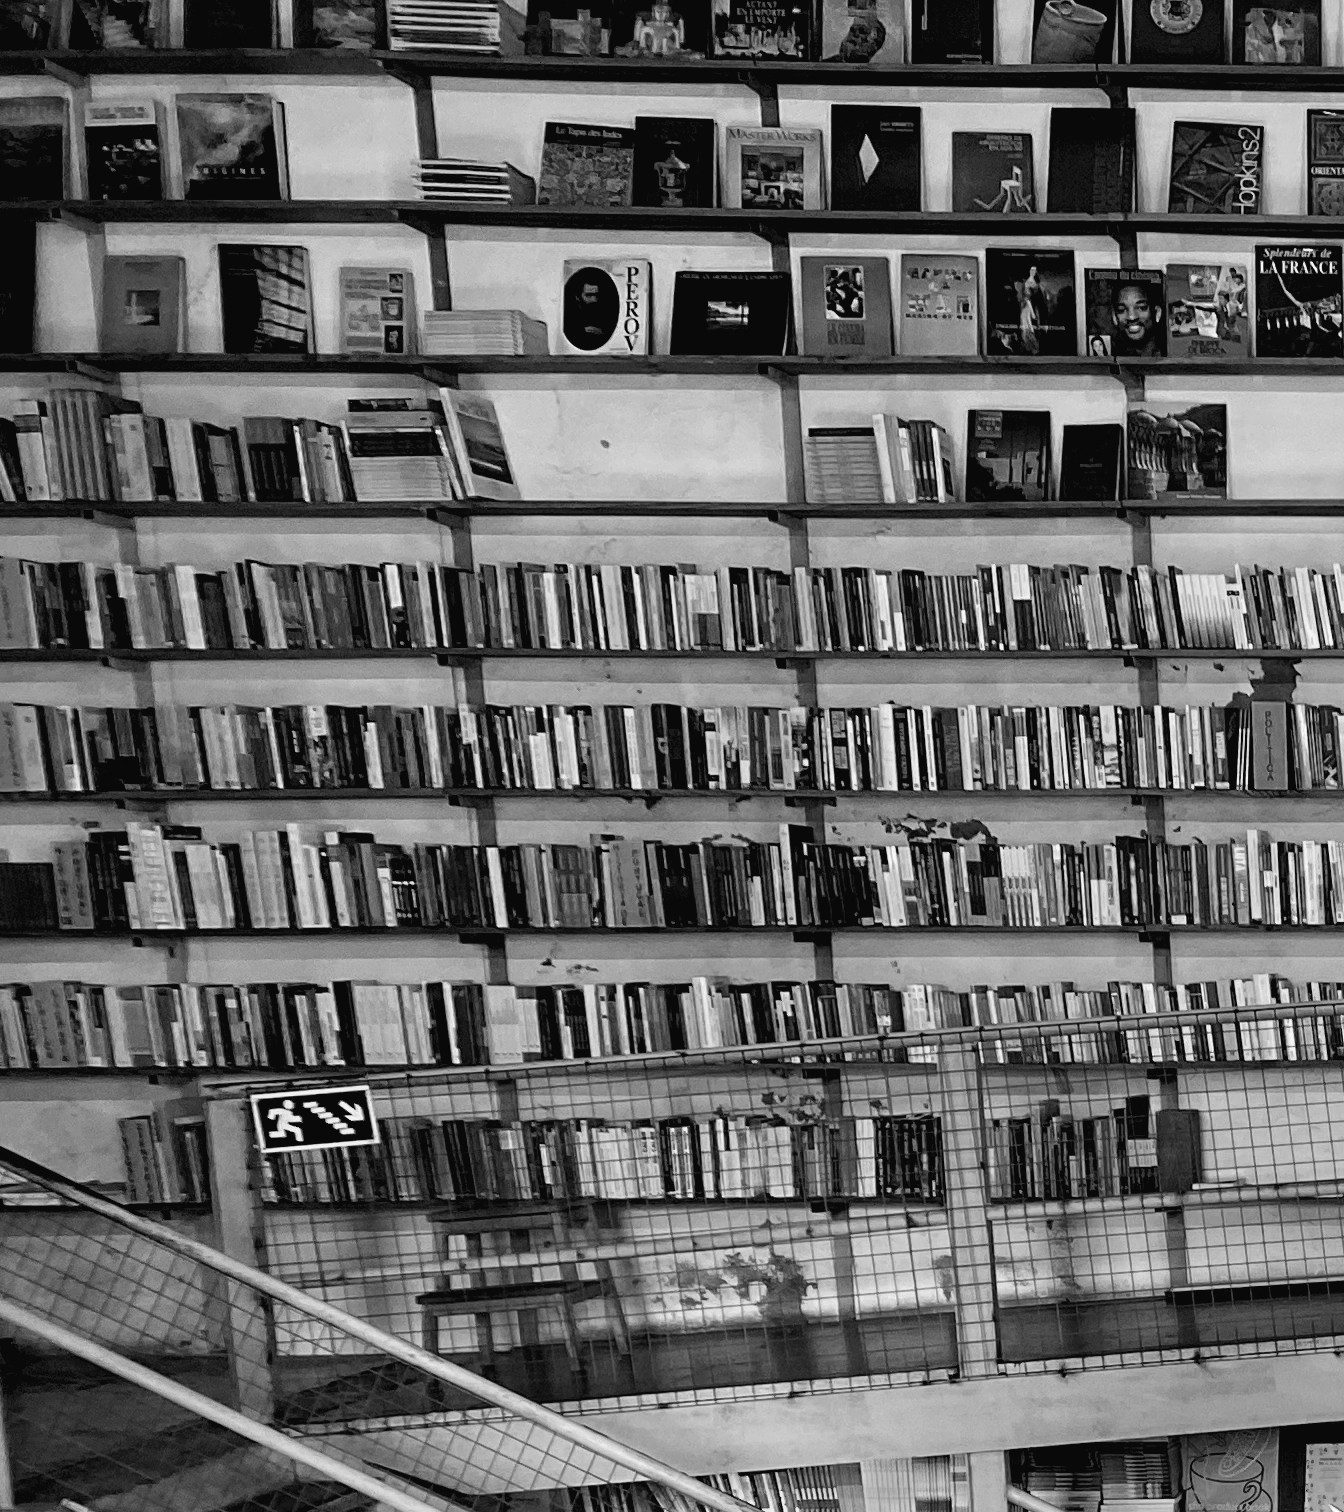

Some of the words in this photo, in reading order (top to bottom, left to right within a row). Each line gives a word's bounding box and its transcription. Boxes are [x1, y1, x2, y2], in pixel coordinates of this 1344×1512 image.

[1263, 247, 1318, 261] Splendeurs
[1320, 248, 1332, 259] de
[1259, 260, 1278, 274] LA
[1280, 260, 1338, 275] FRANCE
[624, 266, 639, 352] PEROV
